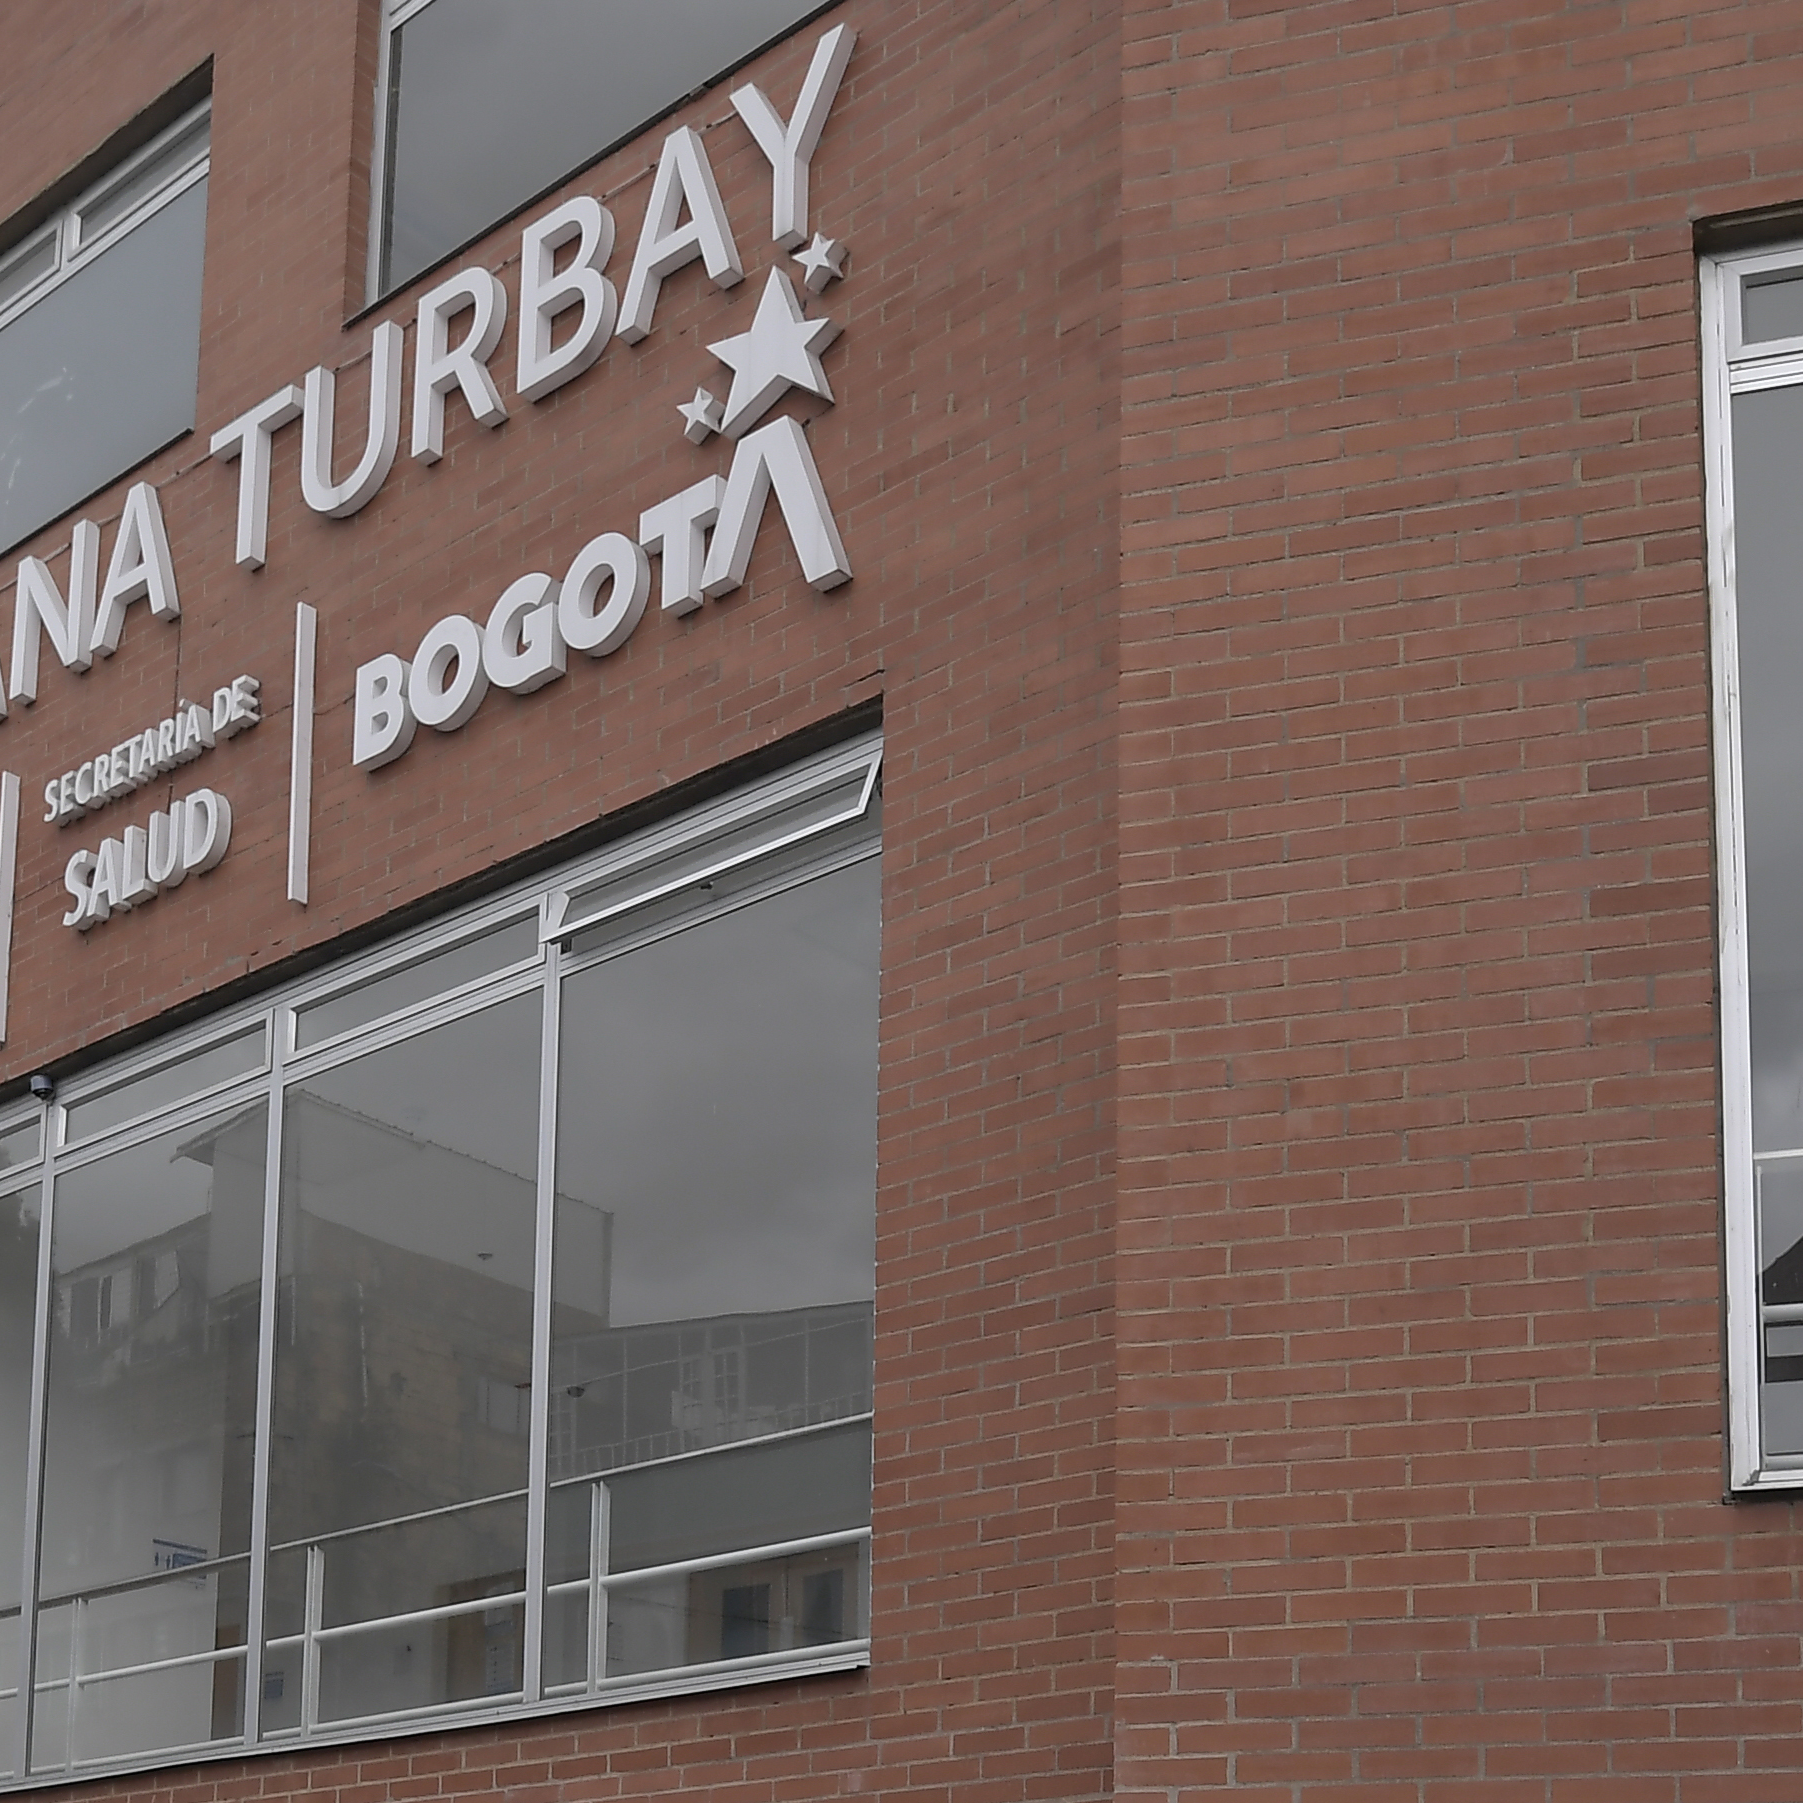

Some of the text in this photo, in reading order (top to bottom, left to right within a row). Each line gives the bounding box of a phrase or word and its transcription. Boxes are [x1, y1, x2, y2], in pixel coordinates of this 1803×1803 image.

[210, 22, 861, 572] TURBAY
[43, 673, 262, 828] SECRETARÍA DE
[62, 788, 232, 930] SALUD
